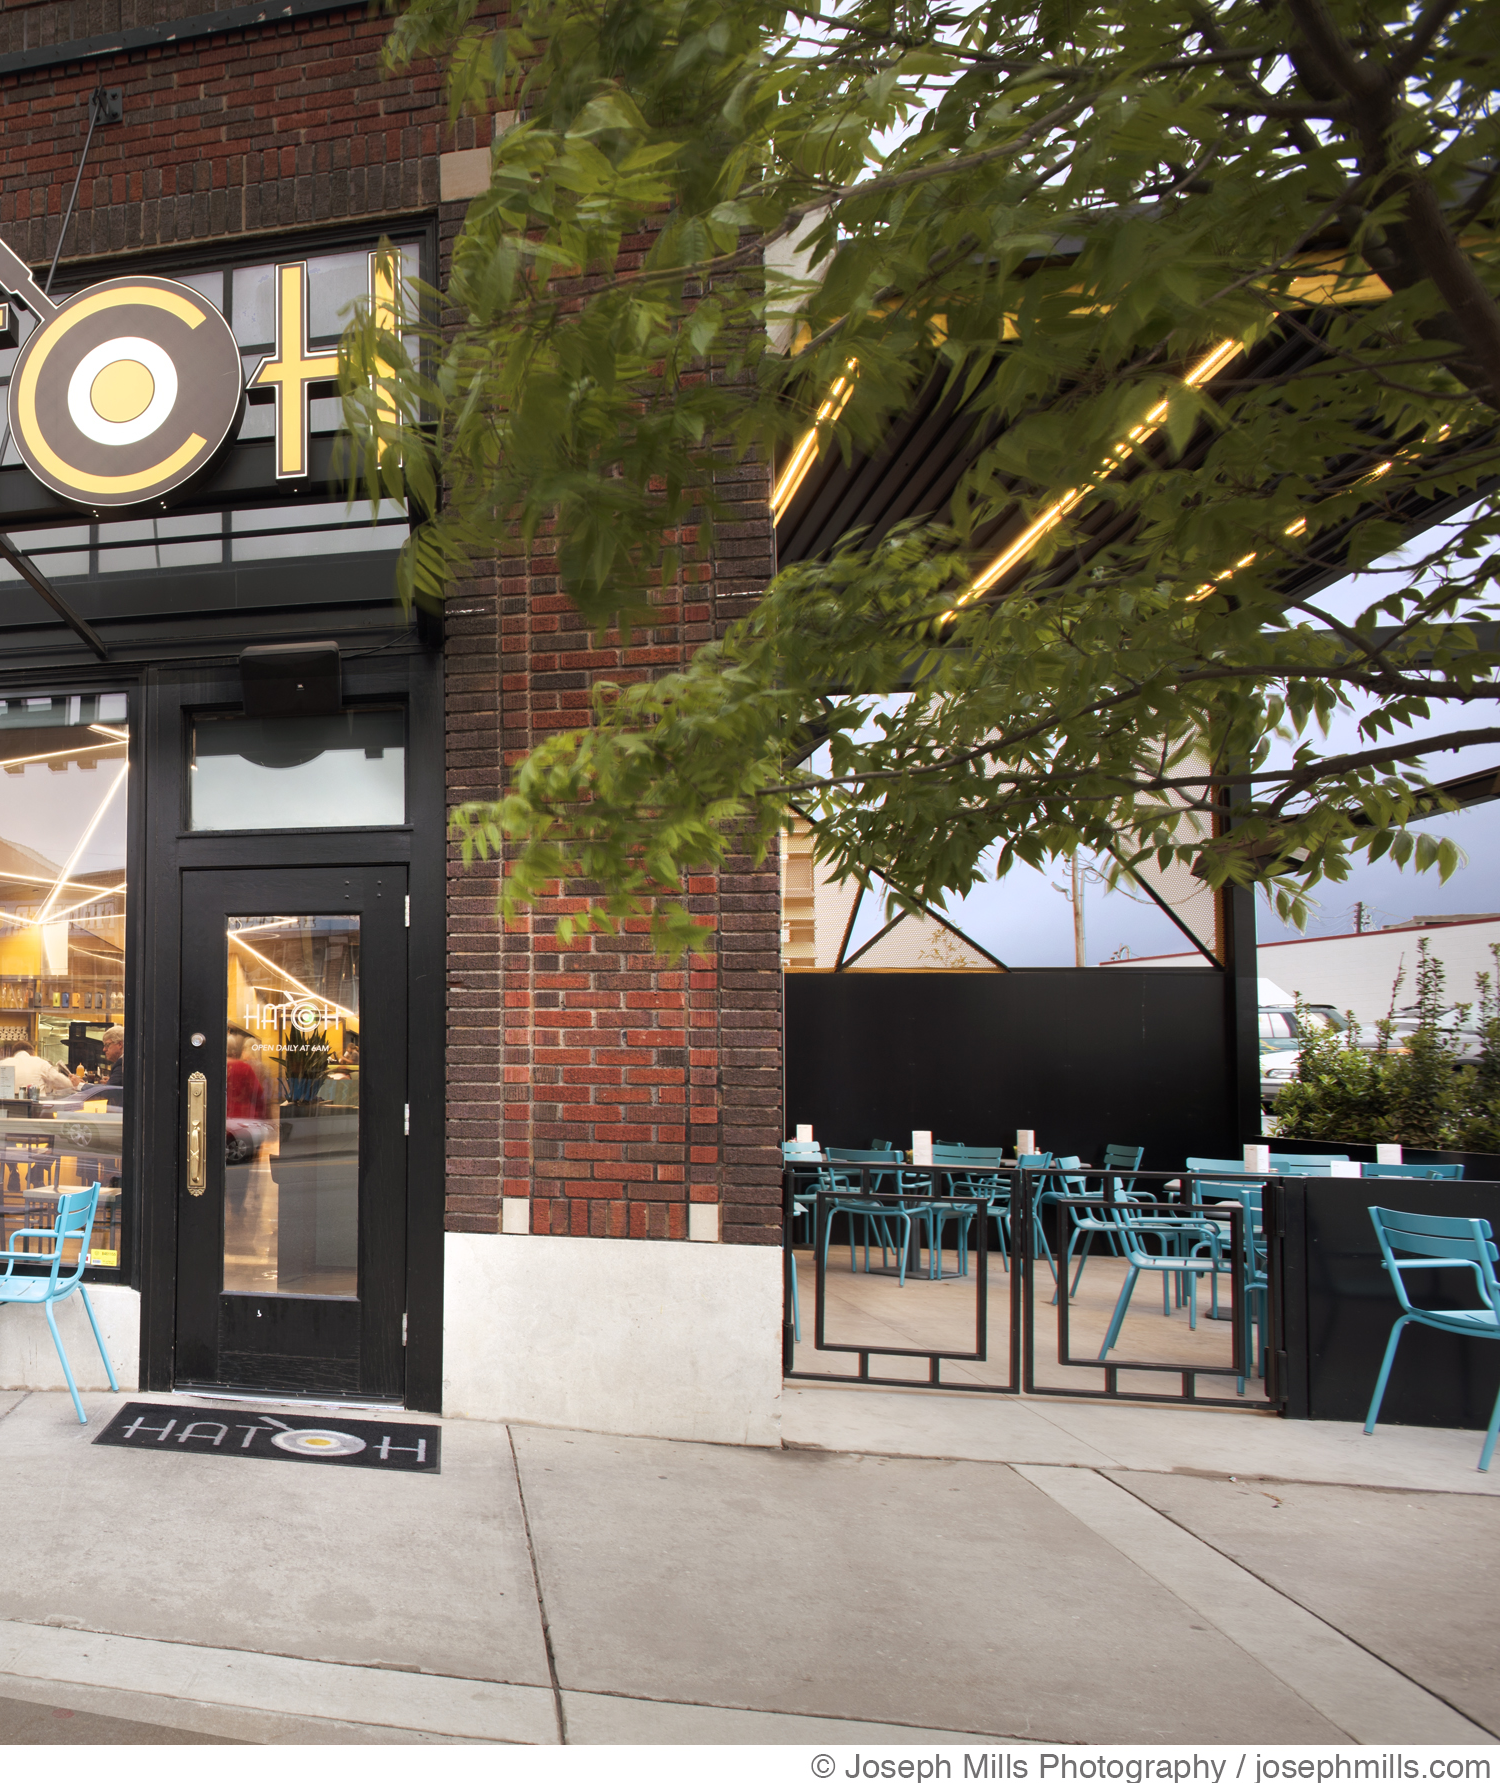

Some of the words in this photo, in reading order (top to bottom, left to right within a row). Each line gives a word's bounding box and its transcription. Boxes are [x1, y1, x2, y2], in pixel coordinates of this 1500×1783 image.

[243, 1001, 340, 1032] HATCH
[251, 1044, 275, 1052] OPEN
[275, 1044, 299, 1052] DAILY
[299, 1044, 311, 1052] AT
[311, 1044, 330, 1052] 6AM
[121, 1416, 427, 1463] HATCH
